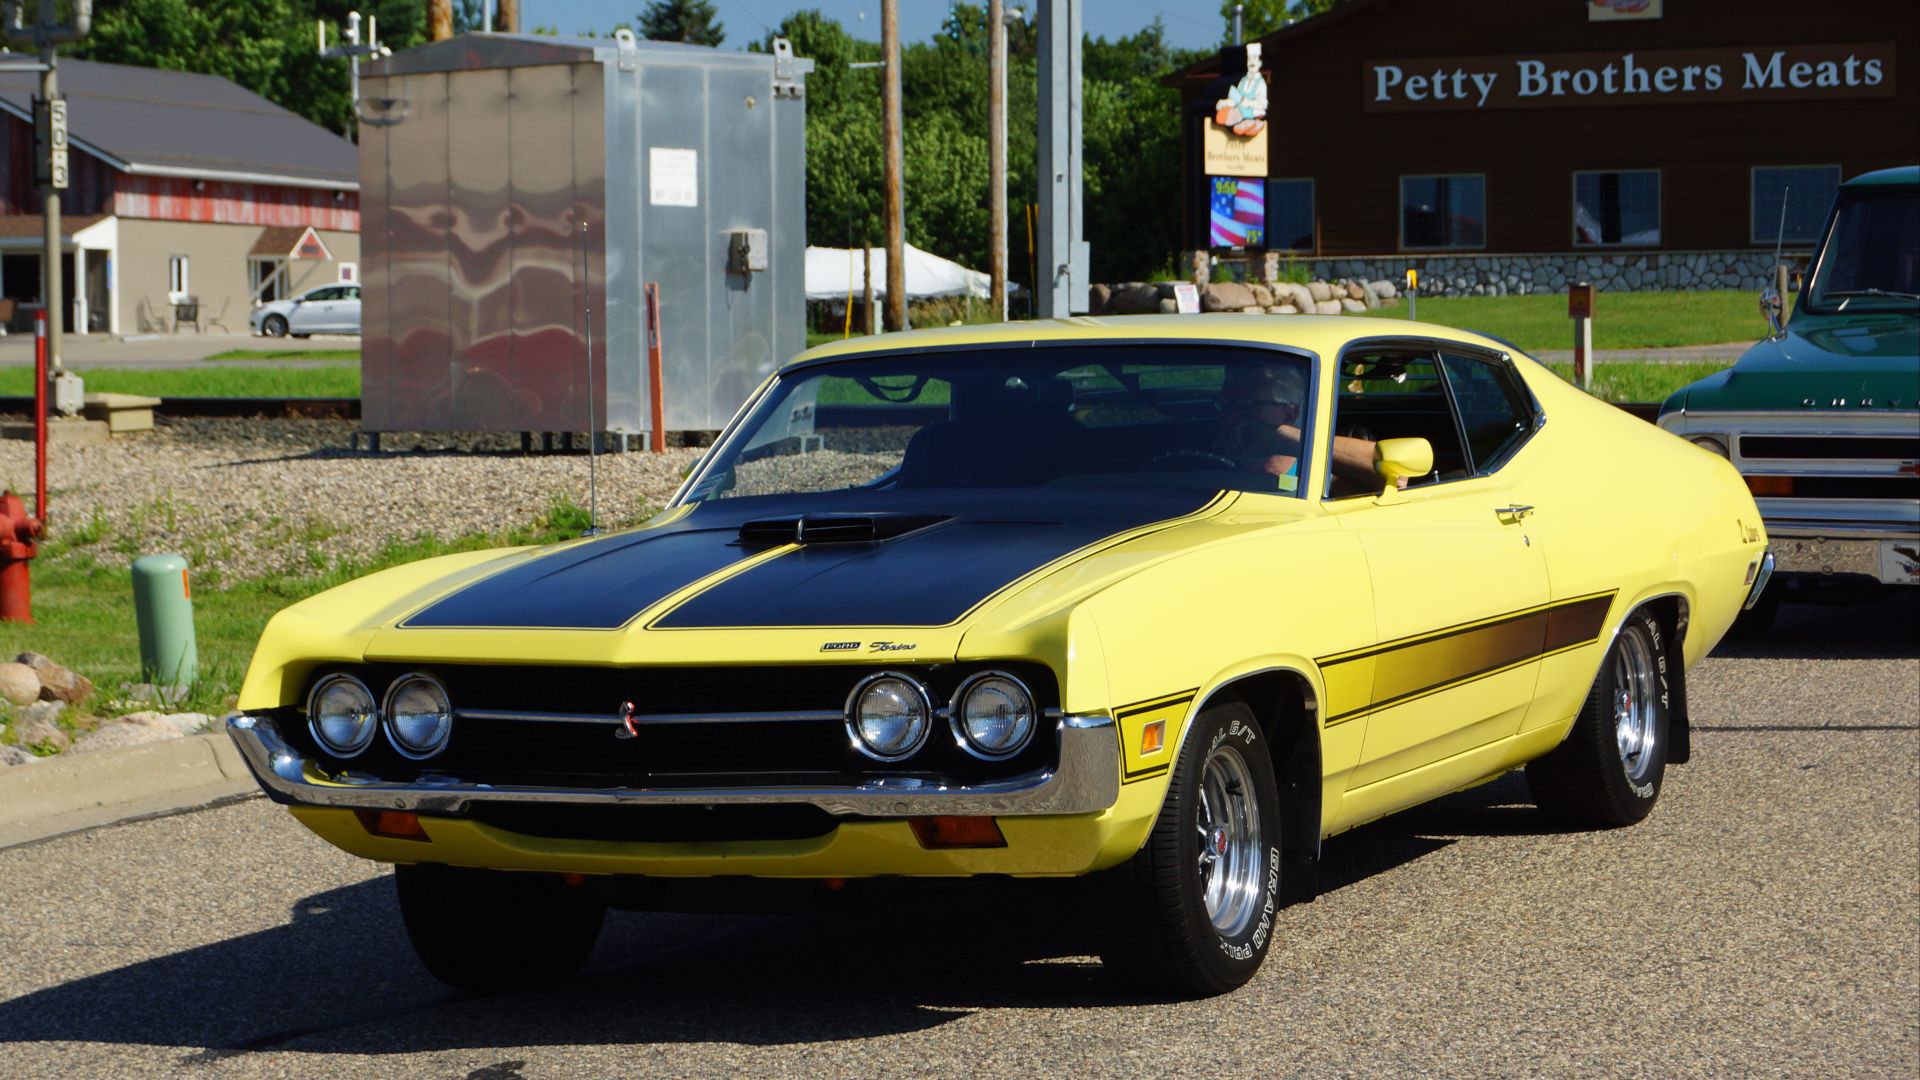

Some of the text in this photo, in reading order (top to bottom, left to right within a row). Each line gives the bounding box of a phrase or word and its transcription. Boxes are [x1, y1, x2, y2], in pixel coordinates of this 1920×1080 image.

[1374, 51, 1884, 107] Petty Brothers Meats
[1229, 720, 1256, 744] G/T
[1252, 847, 1279, 949] GRAND
